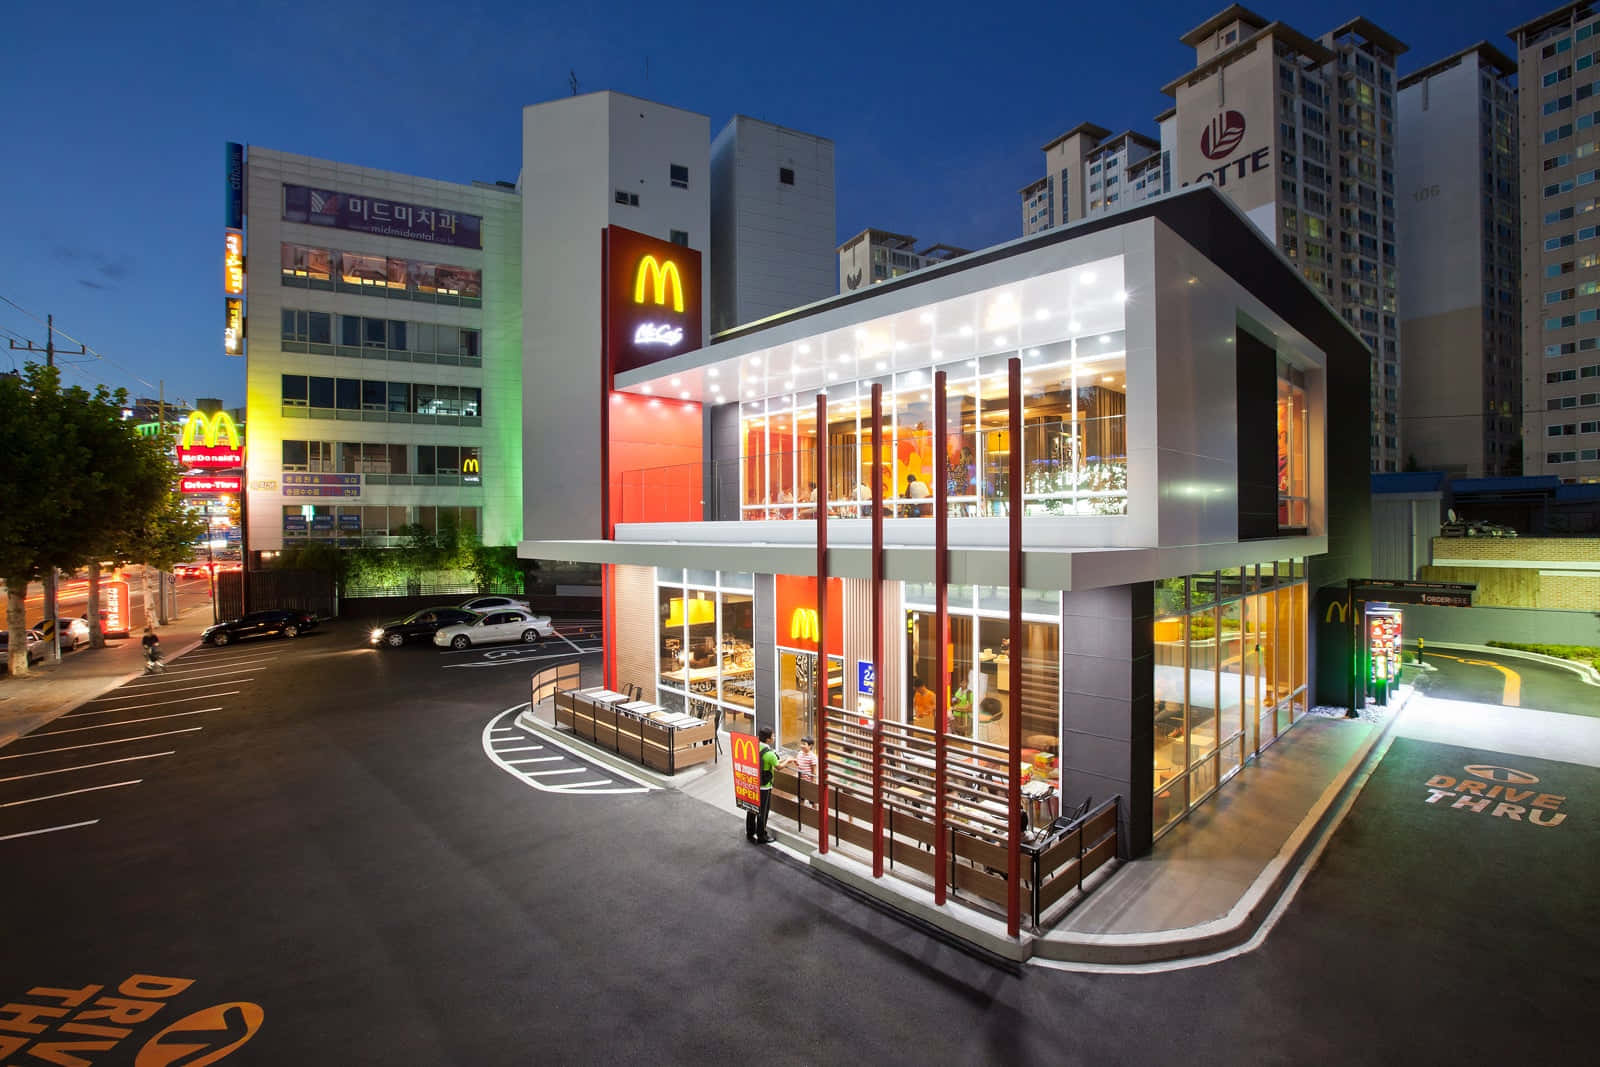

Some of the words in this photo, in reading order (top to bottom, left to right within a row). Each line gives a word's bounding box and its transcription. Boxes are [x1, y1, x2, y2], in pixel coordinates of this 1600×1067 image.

[350, 199, 459, 236] 미드미치과
[181, 454, 241, 462] McDonald's
[735, 785, 760, 802] OPEN
[1424, 774, 1567, 810] DRIVE
[1424, 788, 1568, 828] THRU
[26, 973, 197, 1067] DRIV
